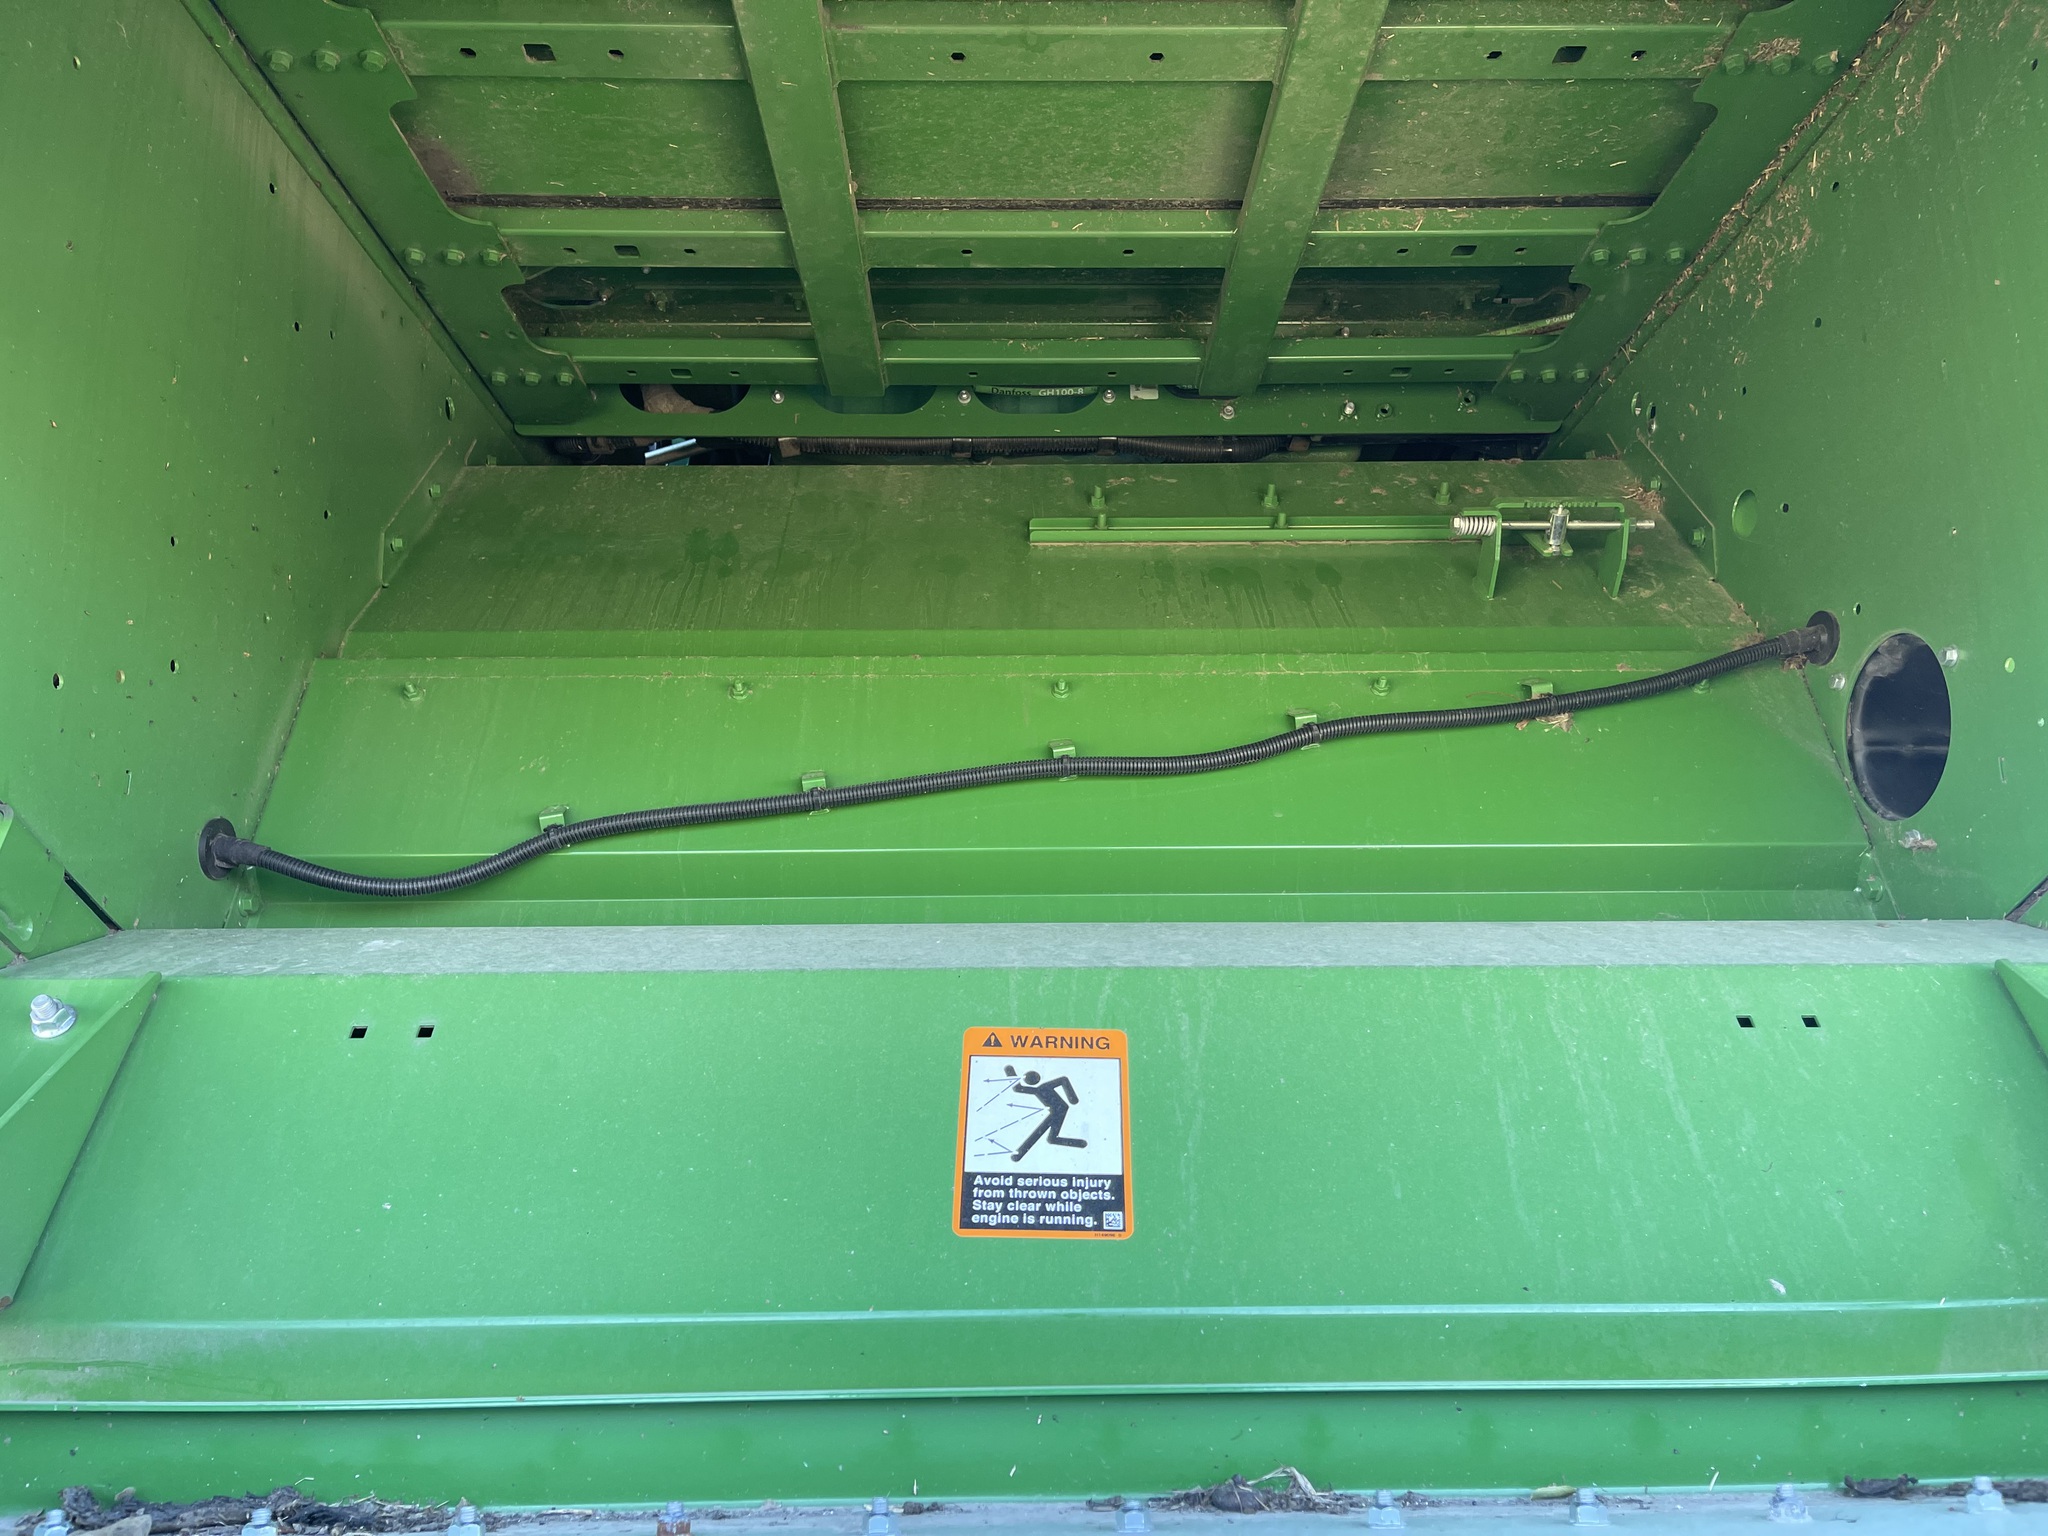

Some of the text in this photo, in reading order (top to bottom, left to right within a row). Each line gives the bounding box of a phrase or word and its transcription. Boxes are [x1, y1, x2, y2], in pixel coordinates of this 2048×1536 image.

[1038, 387, 1084, 396] GH100-8
[1010, 1034, 1110, 1050] WARNING
[973, 1175, 1112, 1190] Avoid serious injury
[972, 1187, 1116, 1202] from thrown objects.
[972, 1200, 1083, 1213] Stay clear while
[971, 1212, 1098, 1228] engine is running.
